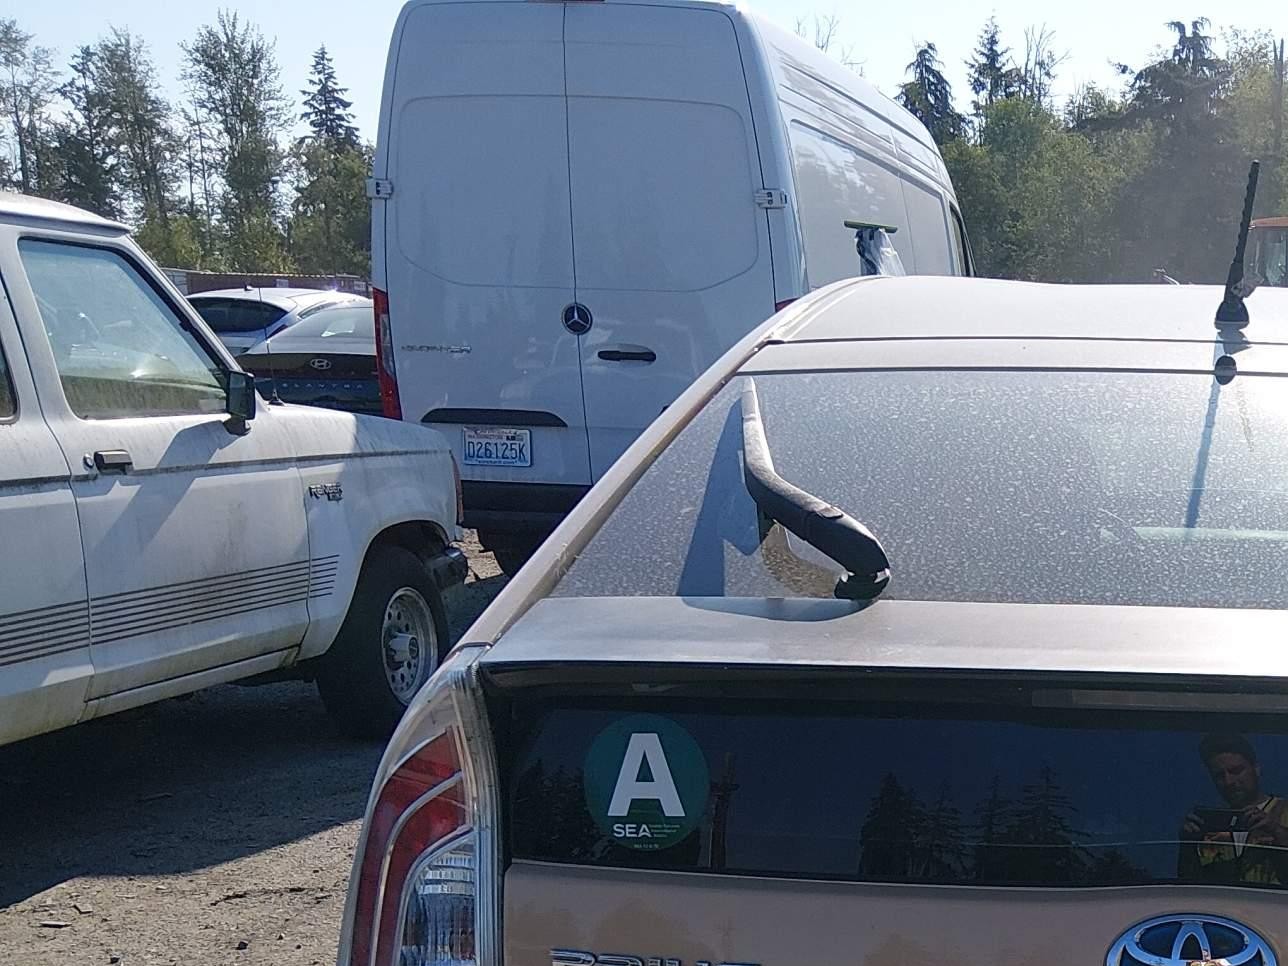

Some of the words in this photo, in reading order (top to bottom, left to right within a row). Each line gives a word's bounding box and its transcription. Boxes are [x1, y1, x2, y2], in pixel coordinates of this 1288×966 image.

[467, 441, 526, 460] D26125K
[607, 732, 686, 817] A
[612, 823, 653, 838] SEA
